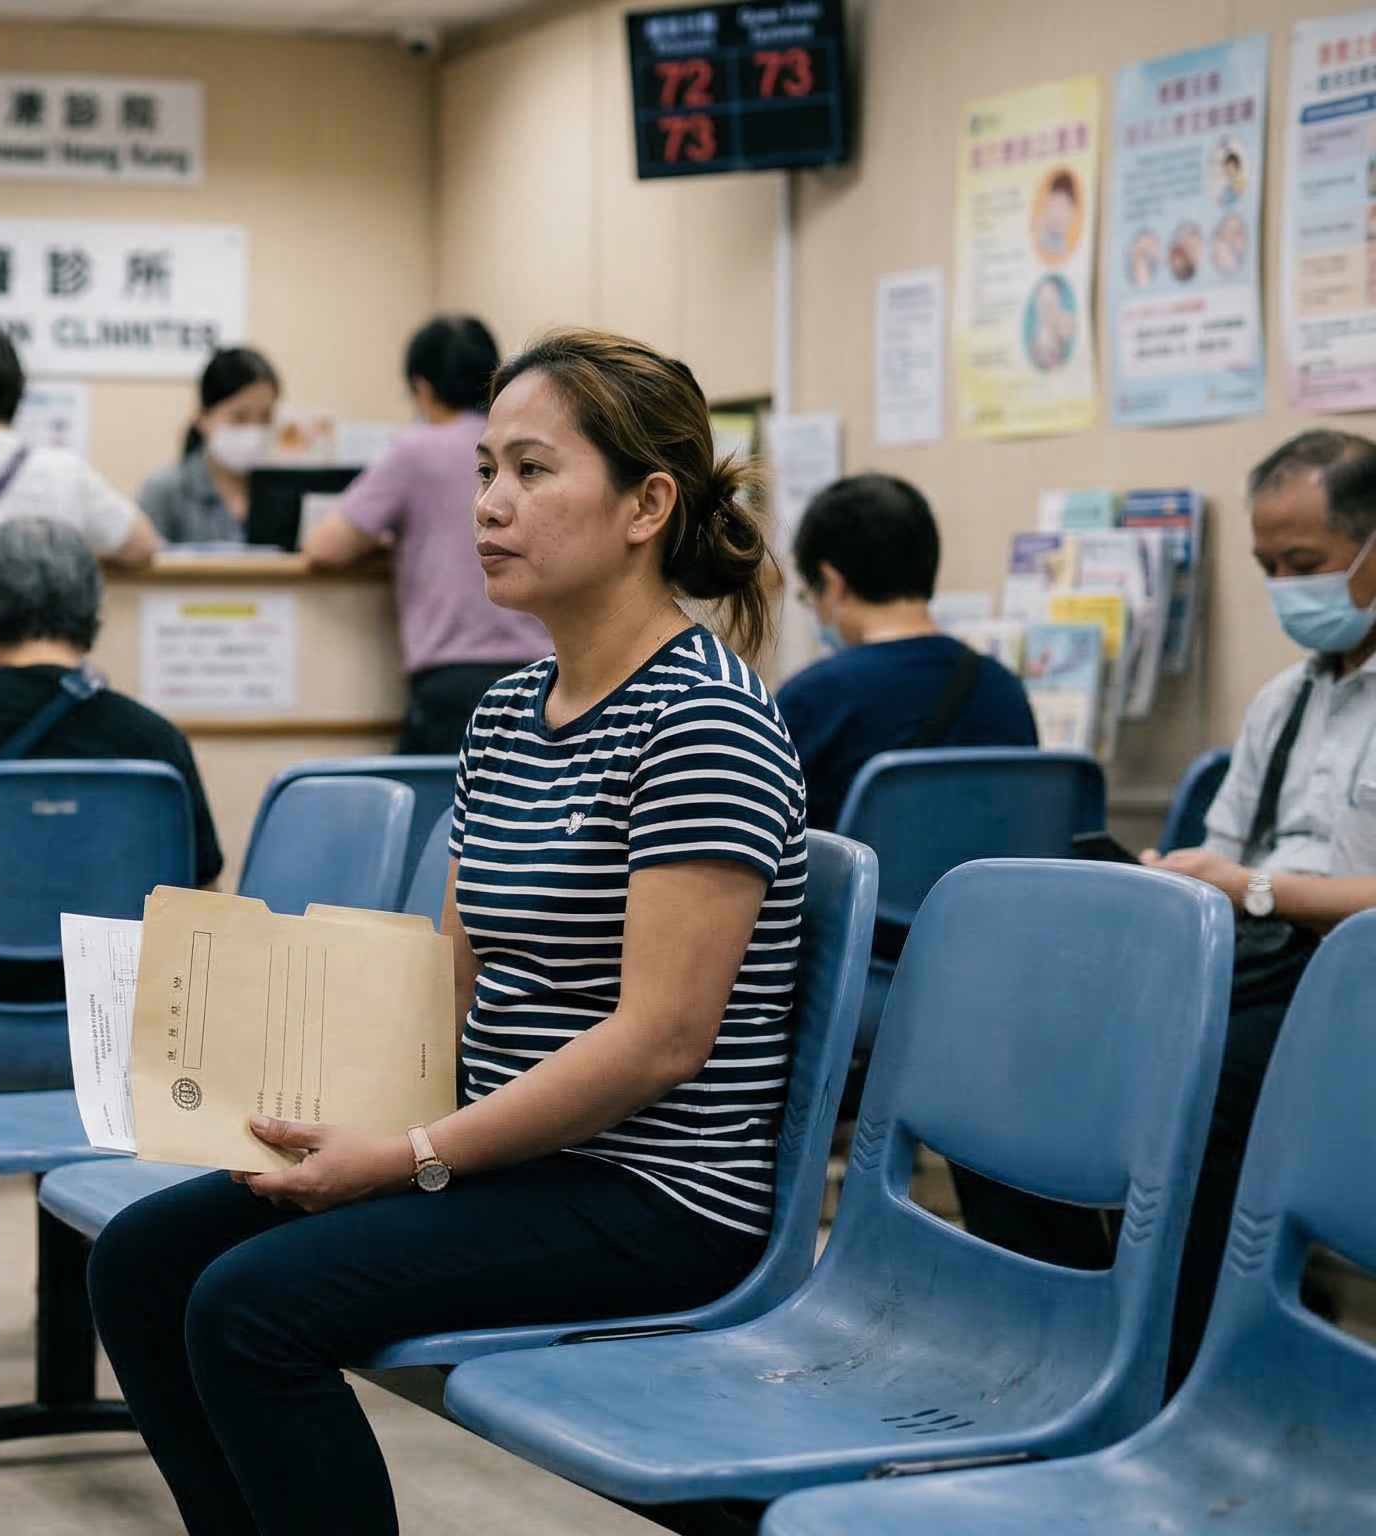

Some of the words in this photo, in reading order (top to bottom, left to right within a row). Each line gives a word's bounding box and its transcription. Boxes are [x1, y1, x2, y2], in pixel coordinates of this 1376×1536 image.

[656, 58, 714, 108] 72
[752, 48, 814, 100] 73
[659, 113, 717, 163] 73
